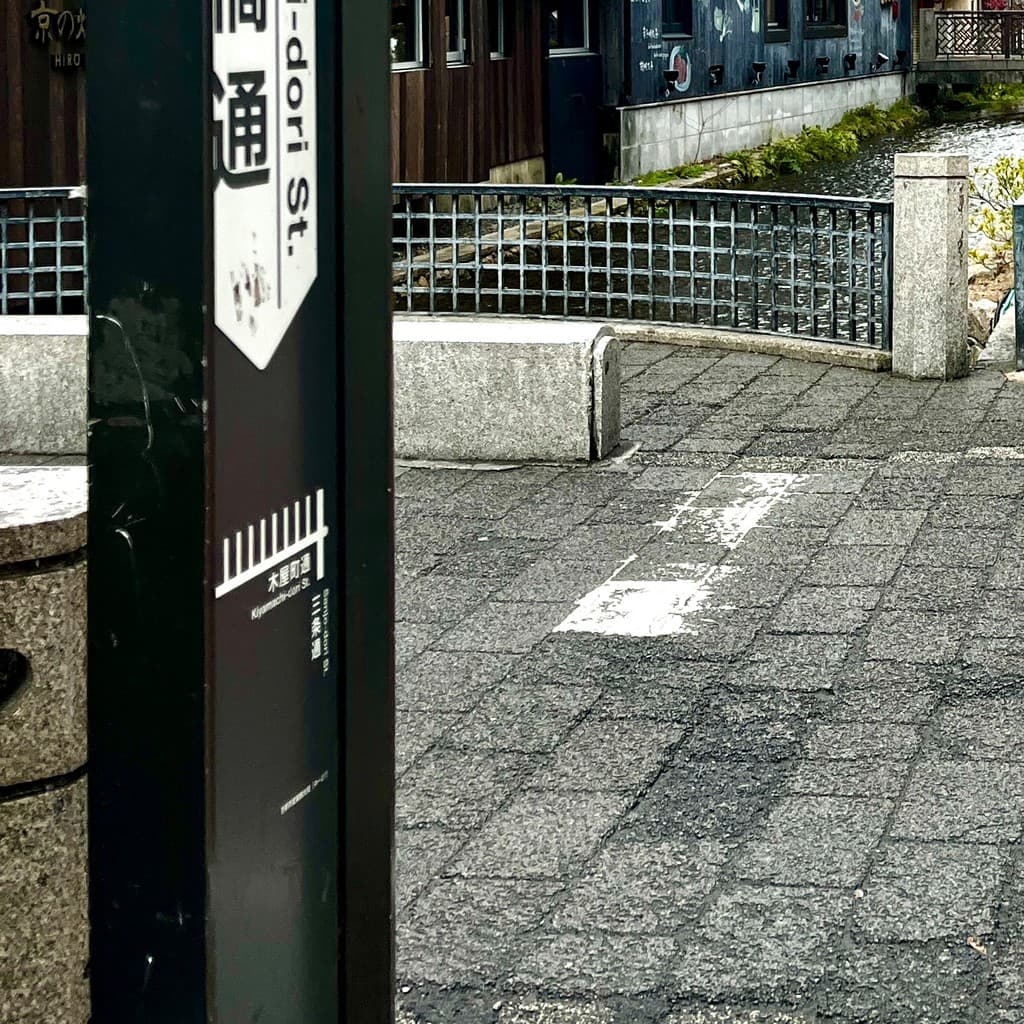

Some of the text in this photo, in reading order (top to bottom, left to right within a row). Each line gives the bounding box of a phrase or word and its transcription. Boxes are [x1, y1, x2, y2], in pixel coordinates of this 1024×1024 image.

[55, 53, 81, 68] HIRO
[286, 176, 310, 257] St.
[267, 552, 311, 593] 木屋町通
[311, 594, 321, 661] 三条通
